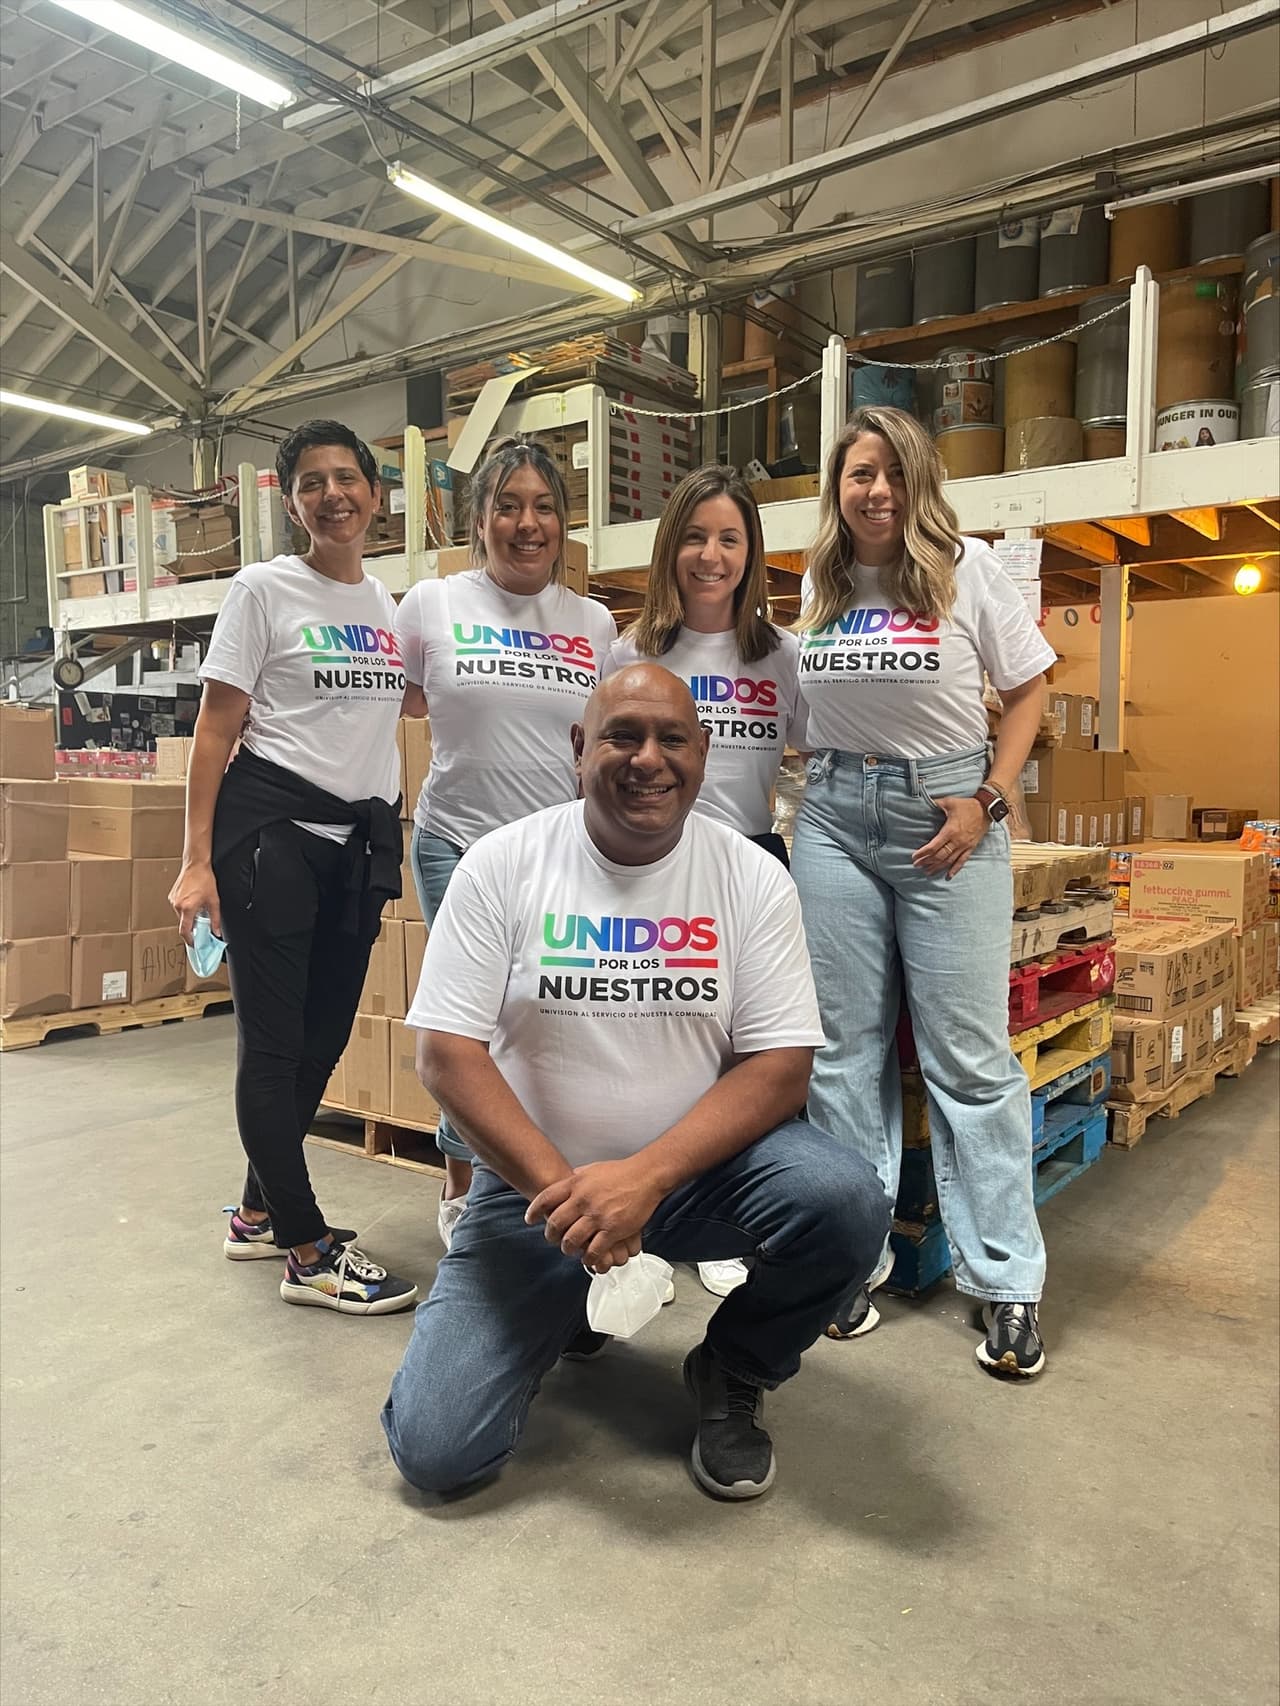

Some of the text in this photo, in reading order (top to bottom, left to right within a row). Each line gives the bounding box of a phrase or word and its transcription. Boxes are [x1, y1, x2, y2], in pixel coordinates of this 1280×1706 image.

[1158, 409, 1238, 427] UNGER IN OUR
[453, 622, 594, 659] UNIDOS
[838, 637, 888, 647] POR LOS
[352, 656, 386, 666] POR LOS
[504, 650, 559, 662] POR LOS
[800, 651, 941, 673] NUESTROS
[314, 670, 406, 690] NUESTRO
[456, 660, 598, 690] NUESTROS
[691, 675, 777, 707] IDOS
[697, 705, 737, 715] OR LOS
[700, 719, 778, 740] STROS
[1143, 884, 1193, 898] fettuccine
[543, 912, 719, 953] UNIDOS
[599, 958, 660, 970] POR LOS
[538, 975, 719, 1002] NUESTROS
[540, 1008, 579, 1017] UNIVISION
[591, 1011, 626, 1019] SERVICIO
